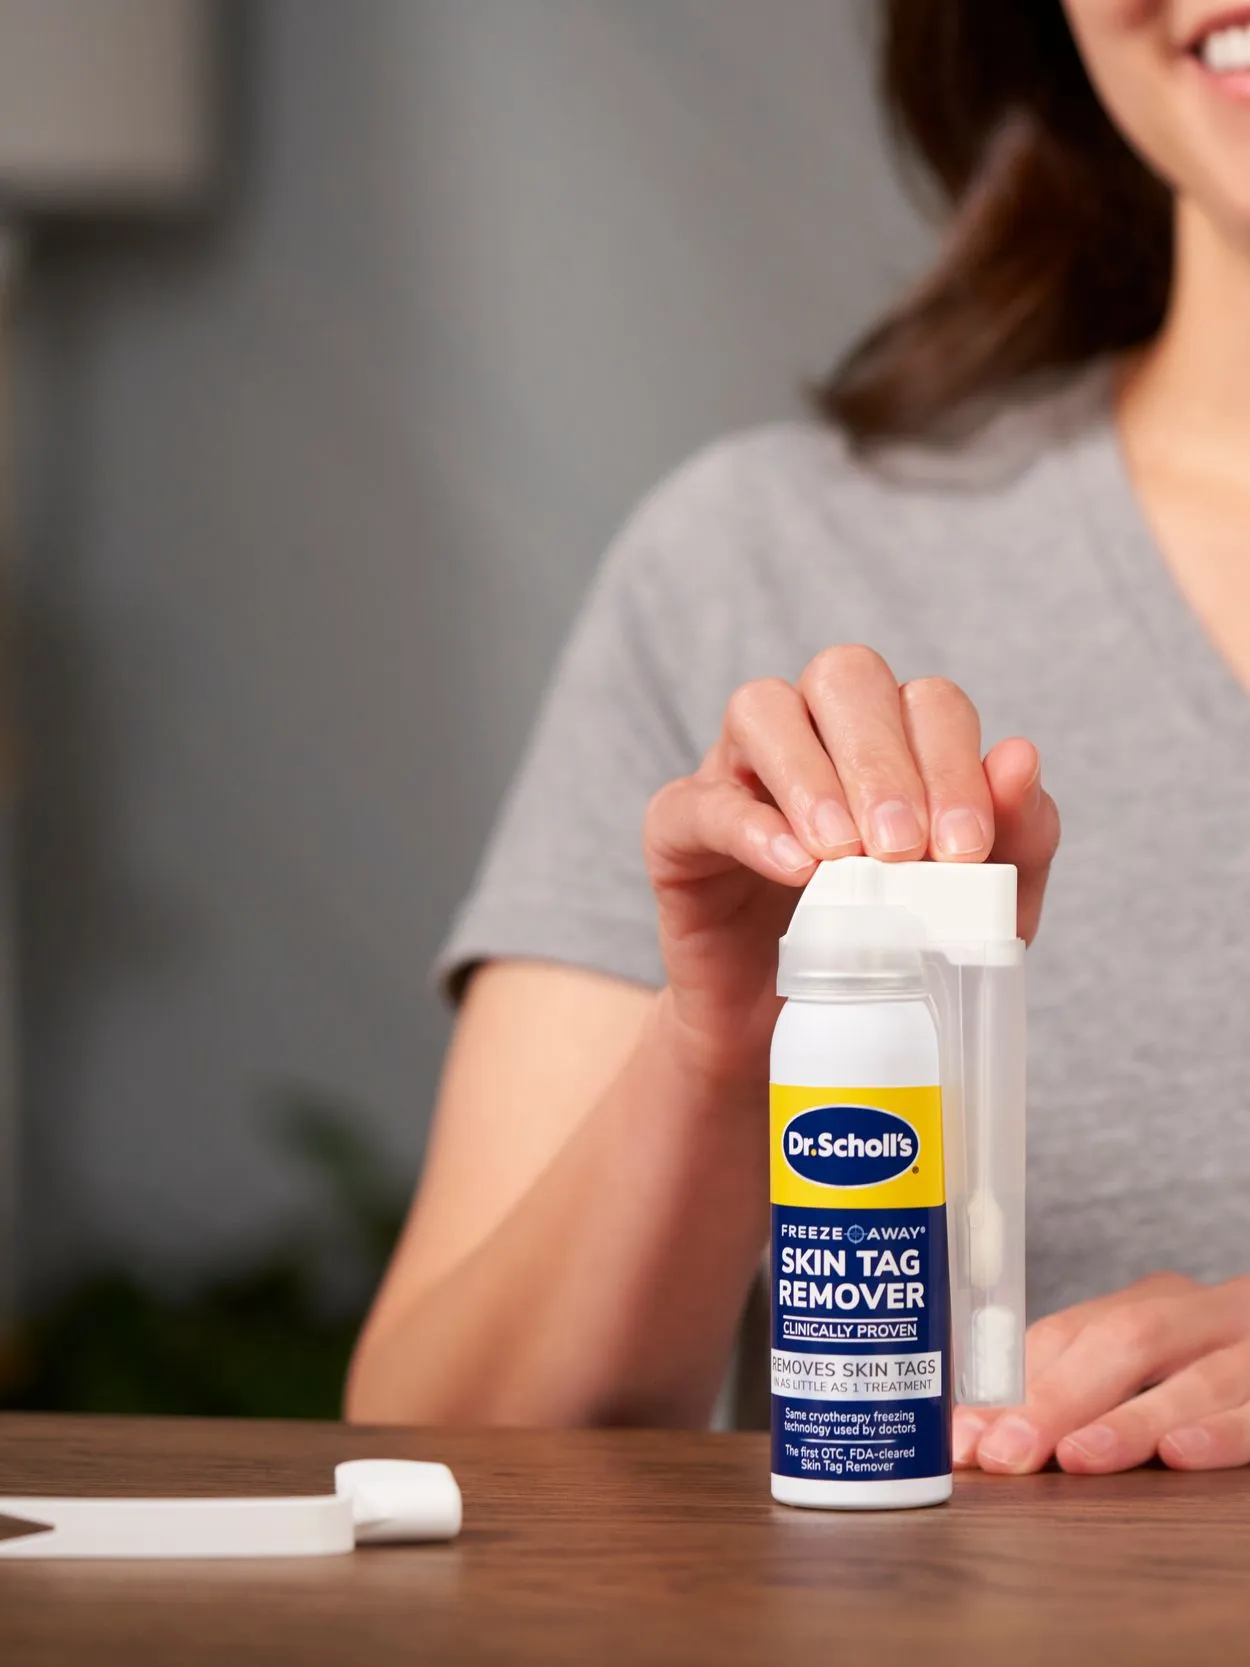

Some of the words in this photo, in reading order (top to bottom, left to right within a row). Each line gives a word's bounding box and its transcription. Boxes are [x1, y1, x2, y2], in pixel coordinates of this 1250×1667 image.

[781, 1224, 843, 1241] FREEZE
[781, 1247, 846, 1277] SKIN
[856, 1249, 920, 1277] TAG
[779, 1279, 925, 1310] REMOVER
[783, 1321, 853, 1338] CLINICALLY
[857, 1324, 917, 1338] PROVEN
[772, 1356, 836, 1377] REMOVES
[842, 1362, 888, 1377] SKIN
[894, 1359, 936, 1375] TAGS
[780, 1378, 791, 1389] AS
[792, 1380, 827, 1392] LITTLE
[830, 1382, 848, 1393] AS
[852, 1382, 859, 1393] 1
[864, 1379, 933, 1393] TREATMENT
[785, 1407, 807, 1421] Same
[808, 1410, 871, 1425] cryotherapy
[873, 1410, 915, 1423] freezing
[784, 1421, 831, 1437] technology
[833, 1423, 860, 1436] used
[862, 1424, 876, 1437] by
[878, 1422, 917, 1435] doctors
[785, 1444, 799, 1457] The
[800, 1446, 819, 1459] first
[821, 1448, 847, 1461] OTC,
[850, 1447, 915, 1460] FDA-cleared
[801, 1459, 821, 1471] Skin
[824, 1460, 843, 1474] Tag
[846, 1461, 894, 1473] Remover
